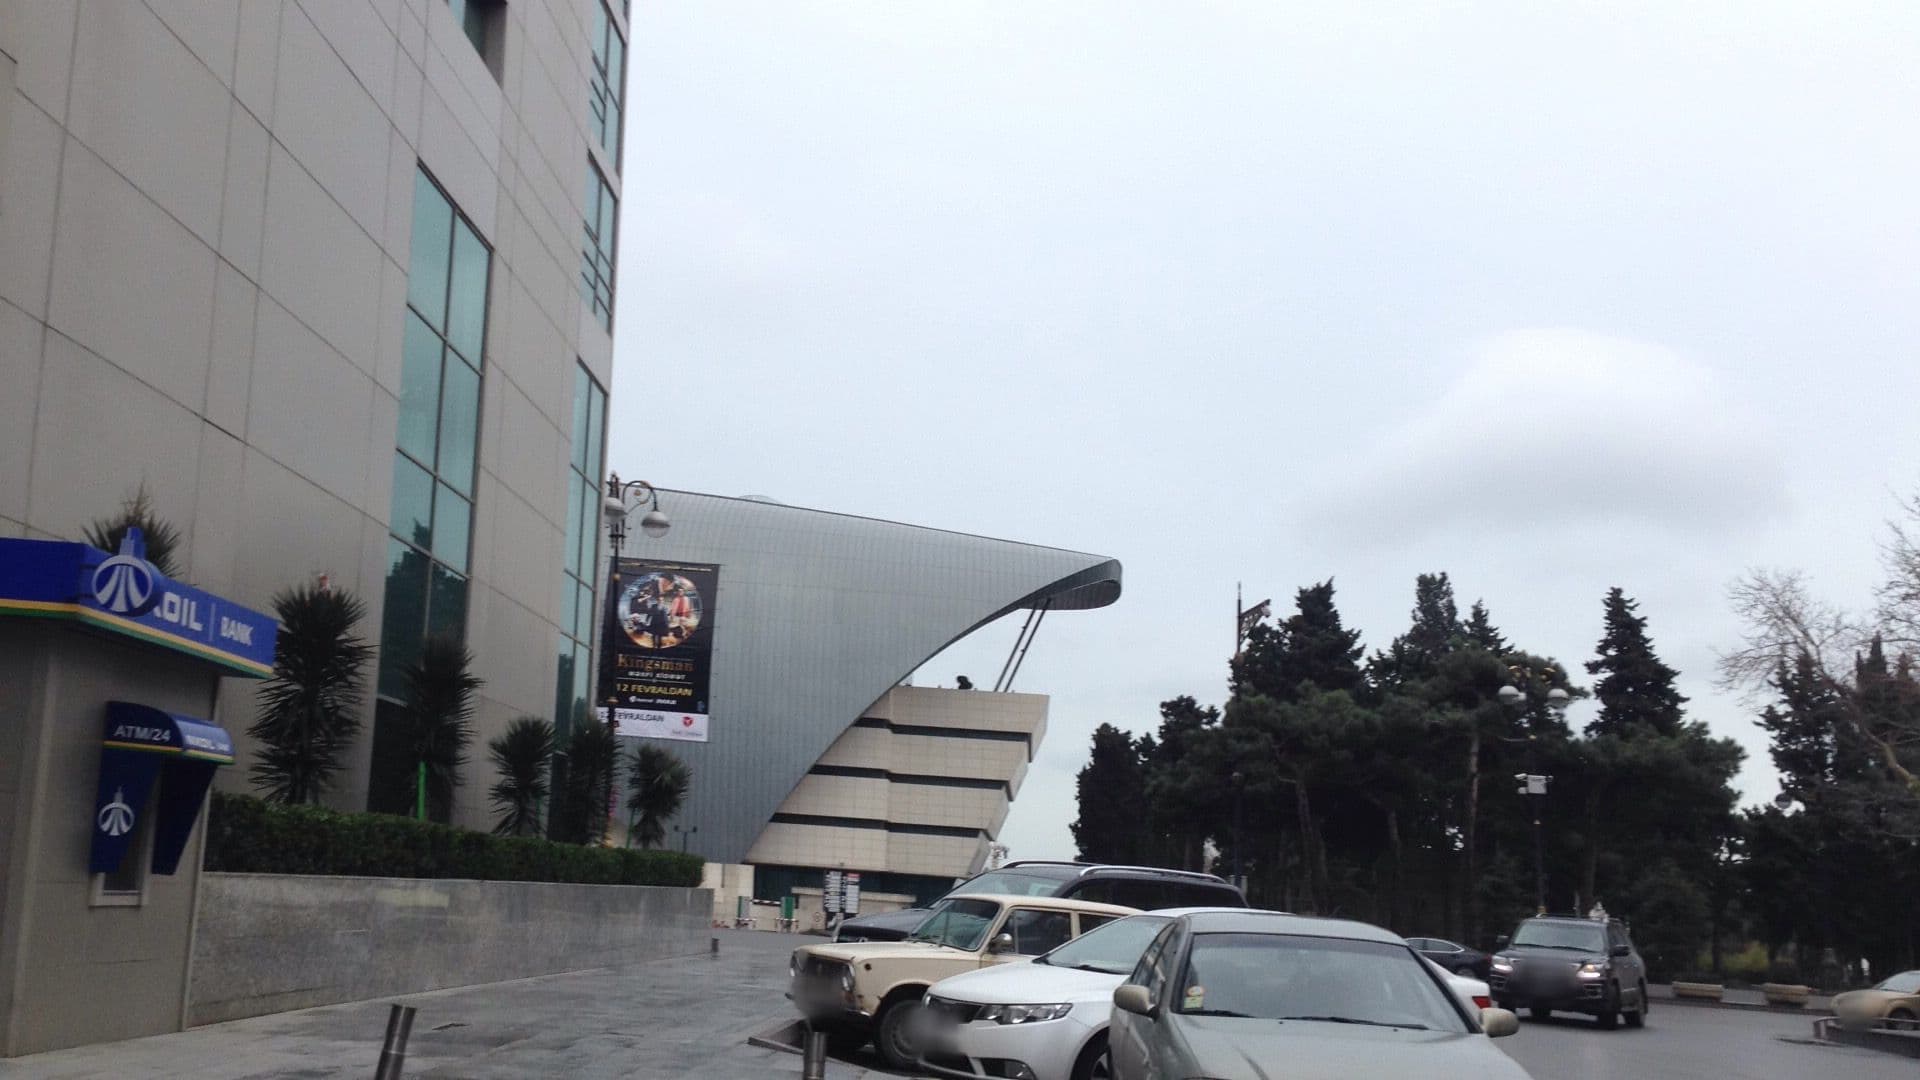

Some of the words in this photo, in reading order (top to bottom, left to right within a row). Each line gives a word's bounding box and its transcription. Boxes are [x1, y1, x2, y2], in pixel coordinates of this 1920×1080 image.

[220, 616, 254, 646] BANK
[616, 654, 694, 671] Kingsman
[616, 683, 630, 692] 12
[631, 684, 693, 696] FEVRALDAN
